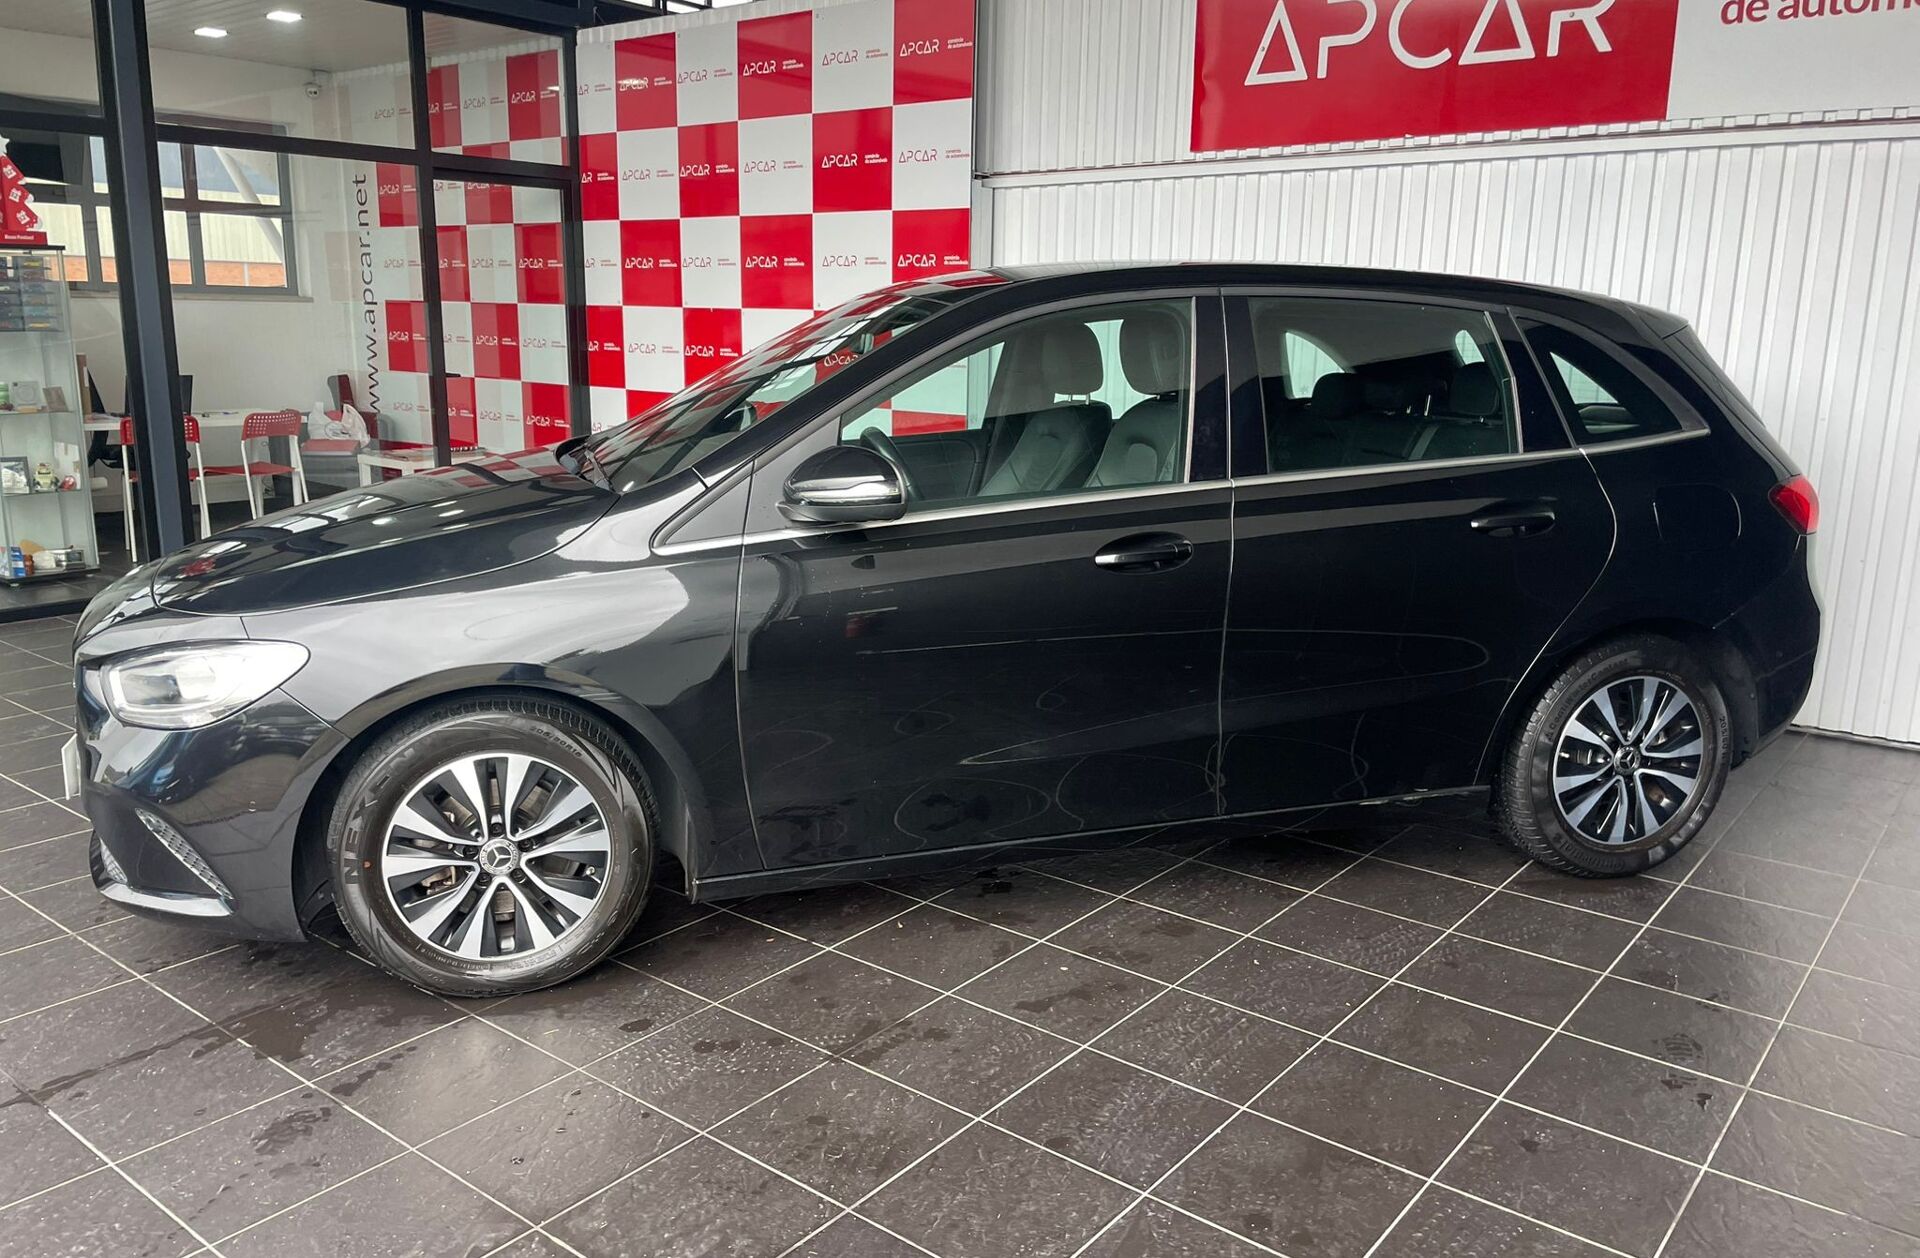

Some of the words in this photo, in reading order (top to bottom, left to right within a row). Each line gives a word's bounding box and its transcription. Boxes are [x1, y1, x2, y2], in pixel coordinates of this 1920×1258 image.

[1720, 0, 1769, 25] de
[1777, 0, 1920, 20] autom
[900, 38, 940, 57] APCAR
[1244, 0, 1613, 86] APCAR
[822, 49, 859, 66] APCAR
[743, 60, 776, 76] APCAR
[677, 69, 708, 84] APCAR
[511, 91, 536, 104] APCAR
[821, 153, 858, 168] APCAR
[899, 149, 938, 163] APCAR
[680, 164, 710, 177] APCAR
[744, 160, 777, 173] APCAR
[622, 169, 651, 180] APCAR
[518, 258, 543, 269] APCAR
[624, 258, 653, 268] APCAR
[682, 256, 712, 267] APCAR
[745, 256, 778, 268] APCAR
[822, 255, 857, 267] APCAR
[897, 254, 936, 267] APCAR
[352, 174, 381, 413] www.apcar.net
[389, 331, 409, 341] APCAR
[476, 336, 498, 346] APCAR
[628, 343, 656, 354] APCAR
[685, 345, 714, 357] APCAR
[526, 415, 550, 427] APCAR
[344, 748, 415, 885] NEXEN
